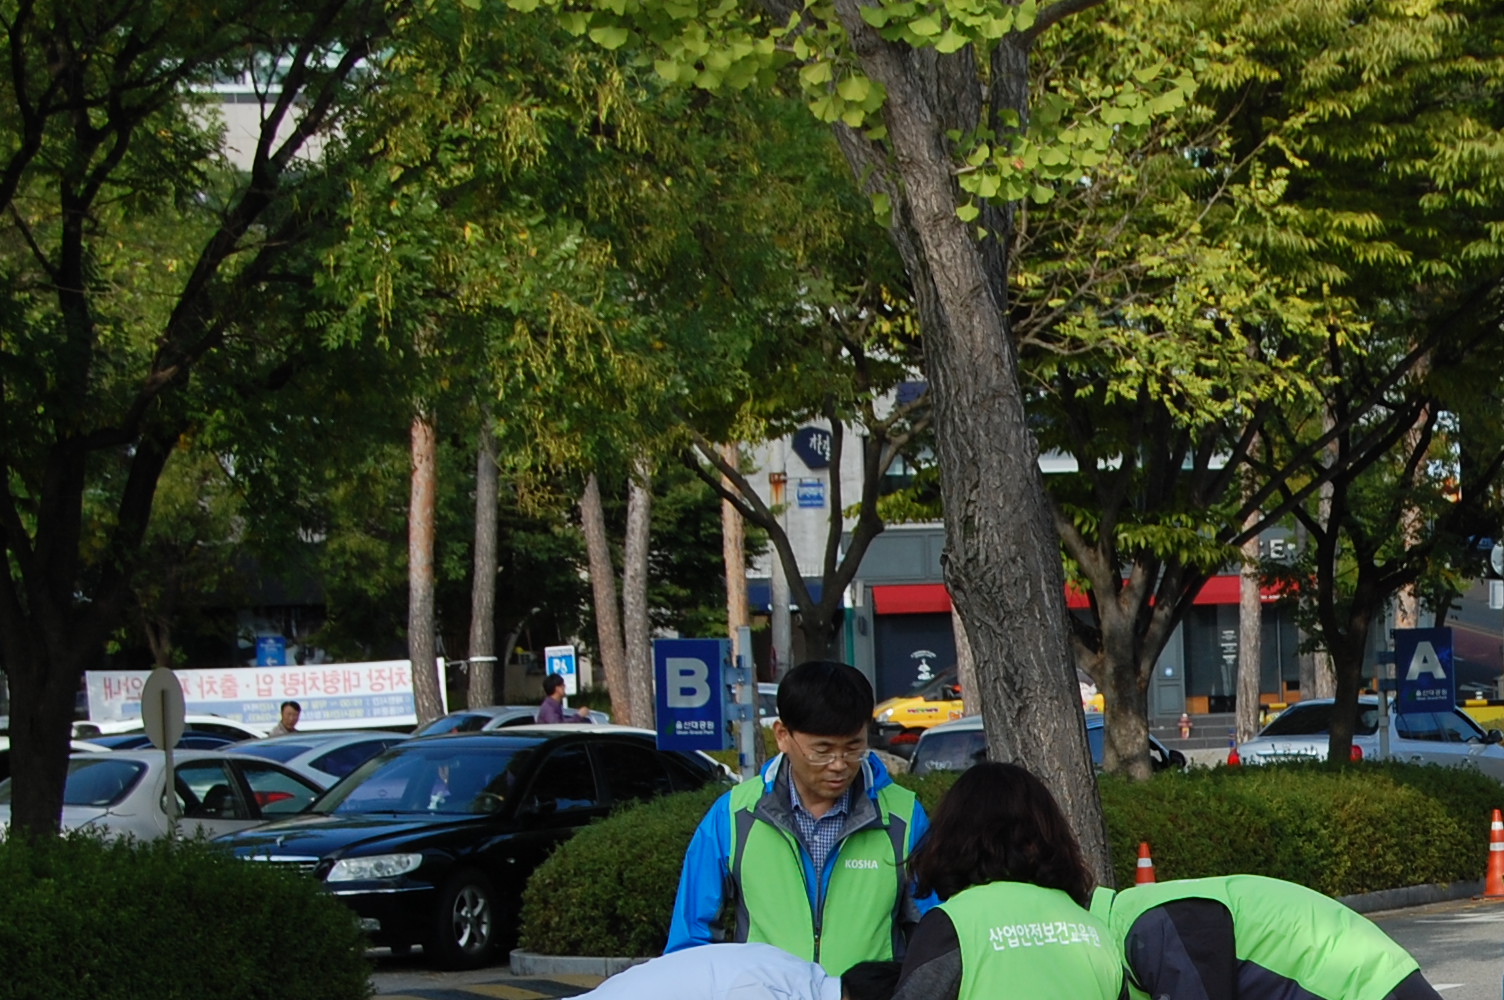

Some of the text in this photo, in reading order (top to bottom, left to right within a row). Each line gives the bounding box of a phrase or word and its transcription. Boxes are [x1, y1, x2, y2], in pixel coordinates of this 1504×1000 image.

[1406, 641, 1447, 680] A
[666, 657, 711, 709] B
[845, 859, 879, 869] KOSHA
[989, 921, 1102, 951] 산업안전보건교육원
